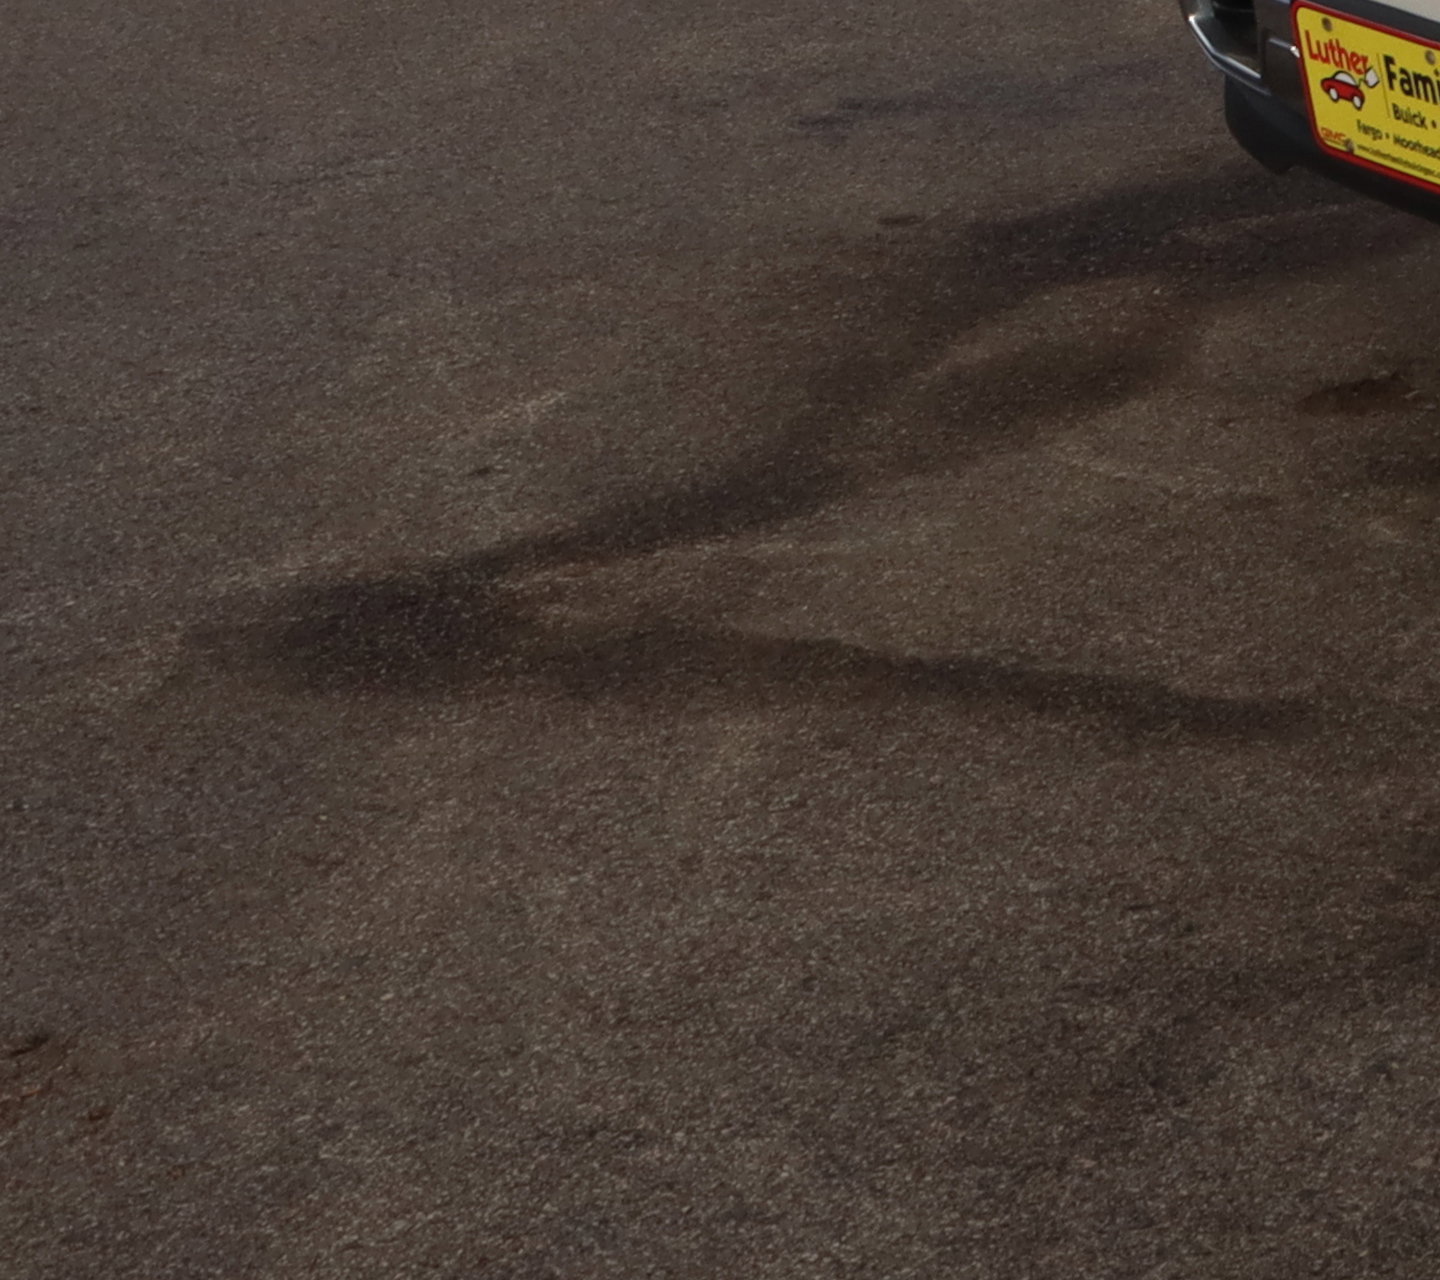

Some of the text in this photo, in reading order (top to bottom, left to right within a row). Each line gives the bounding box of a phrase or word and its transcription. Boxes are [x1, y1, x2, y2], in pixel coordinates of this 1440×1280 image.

[1304, 29, 1369, 76] Luther
[1356, 118, 1383, 141] Fargo
[1391, 102, 1428, 130] Buick
